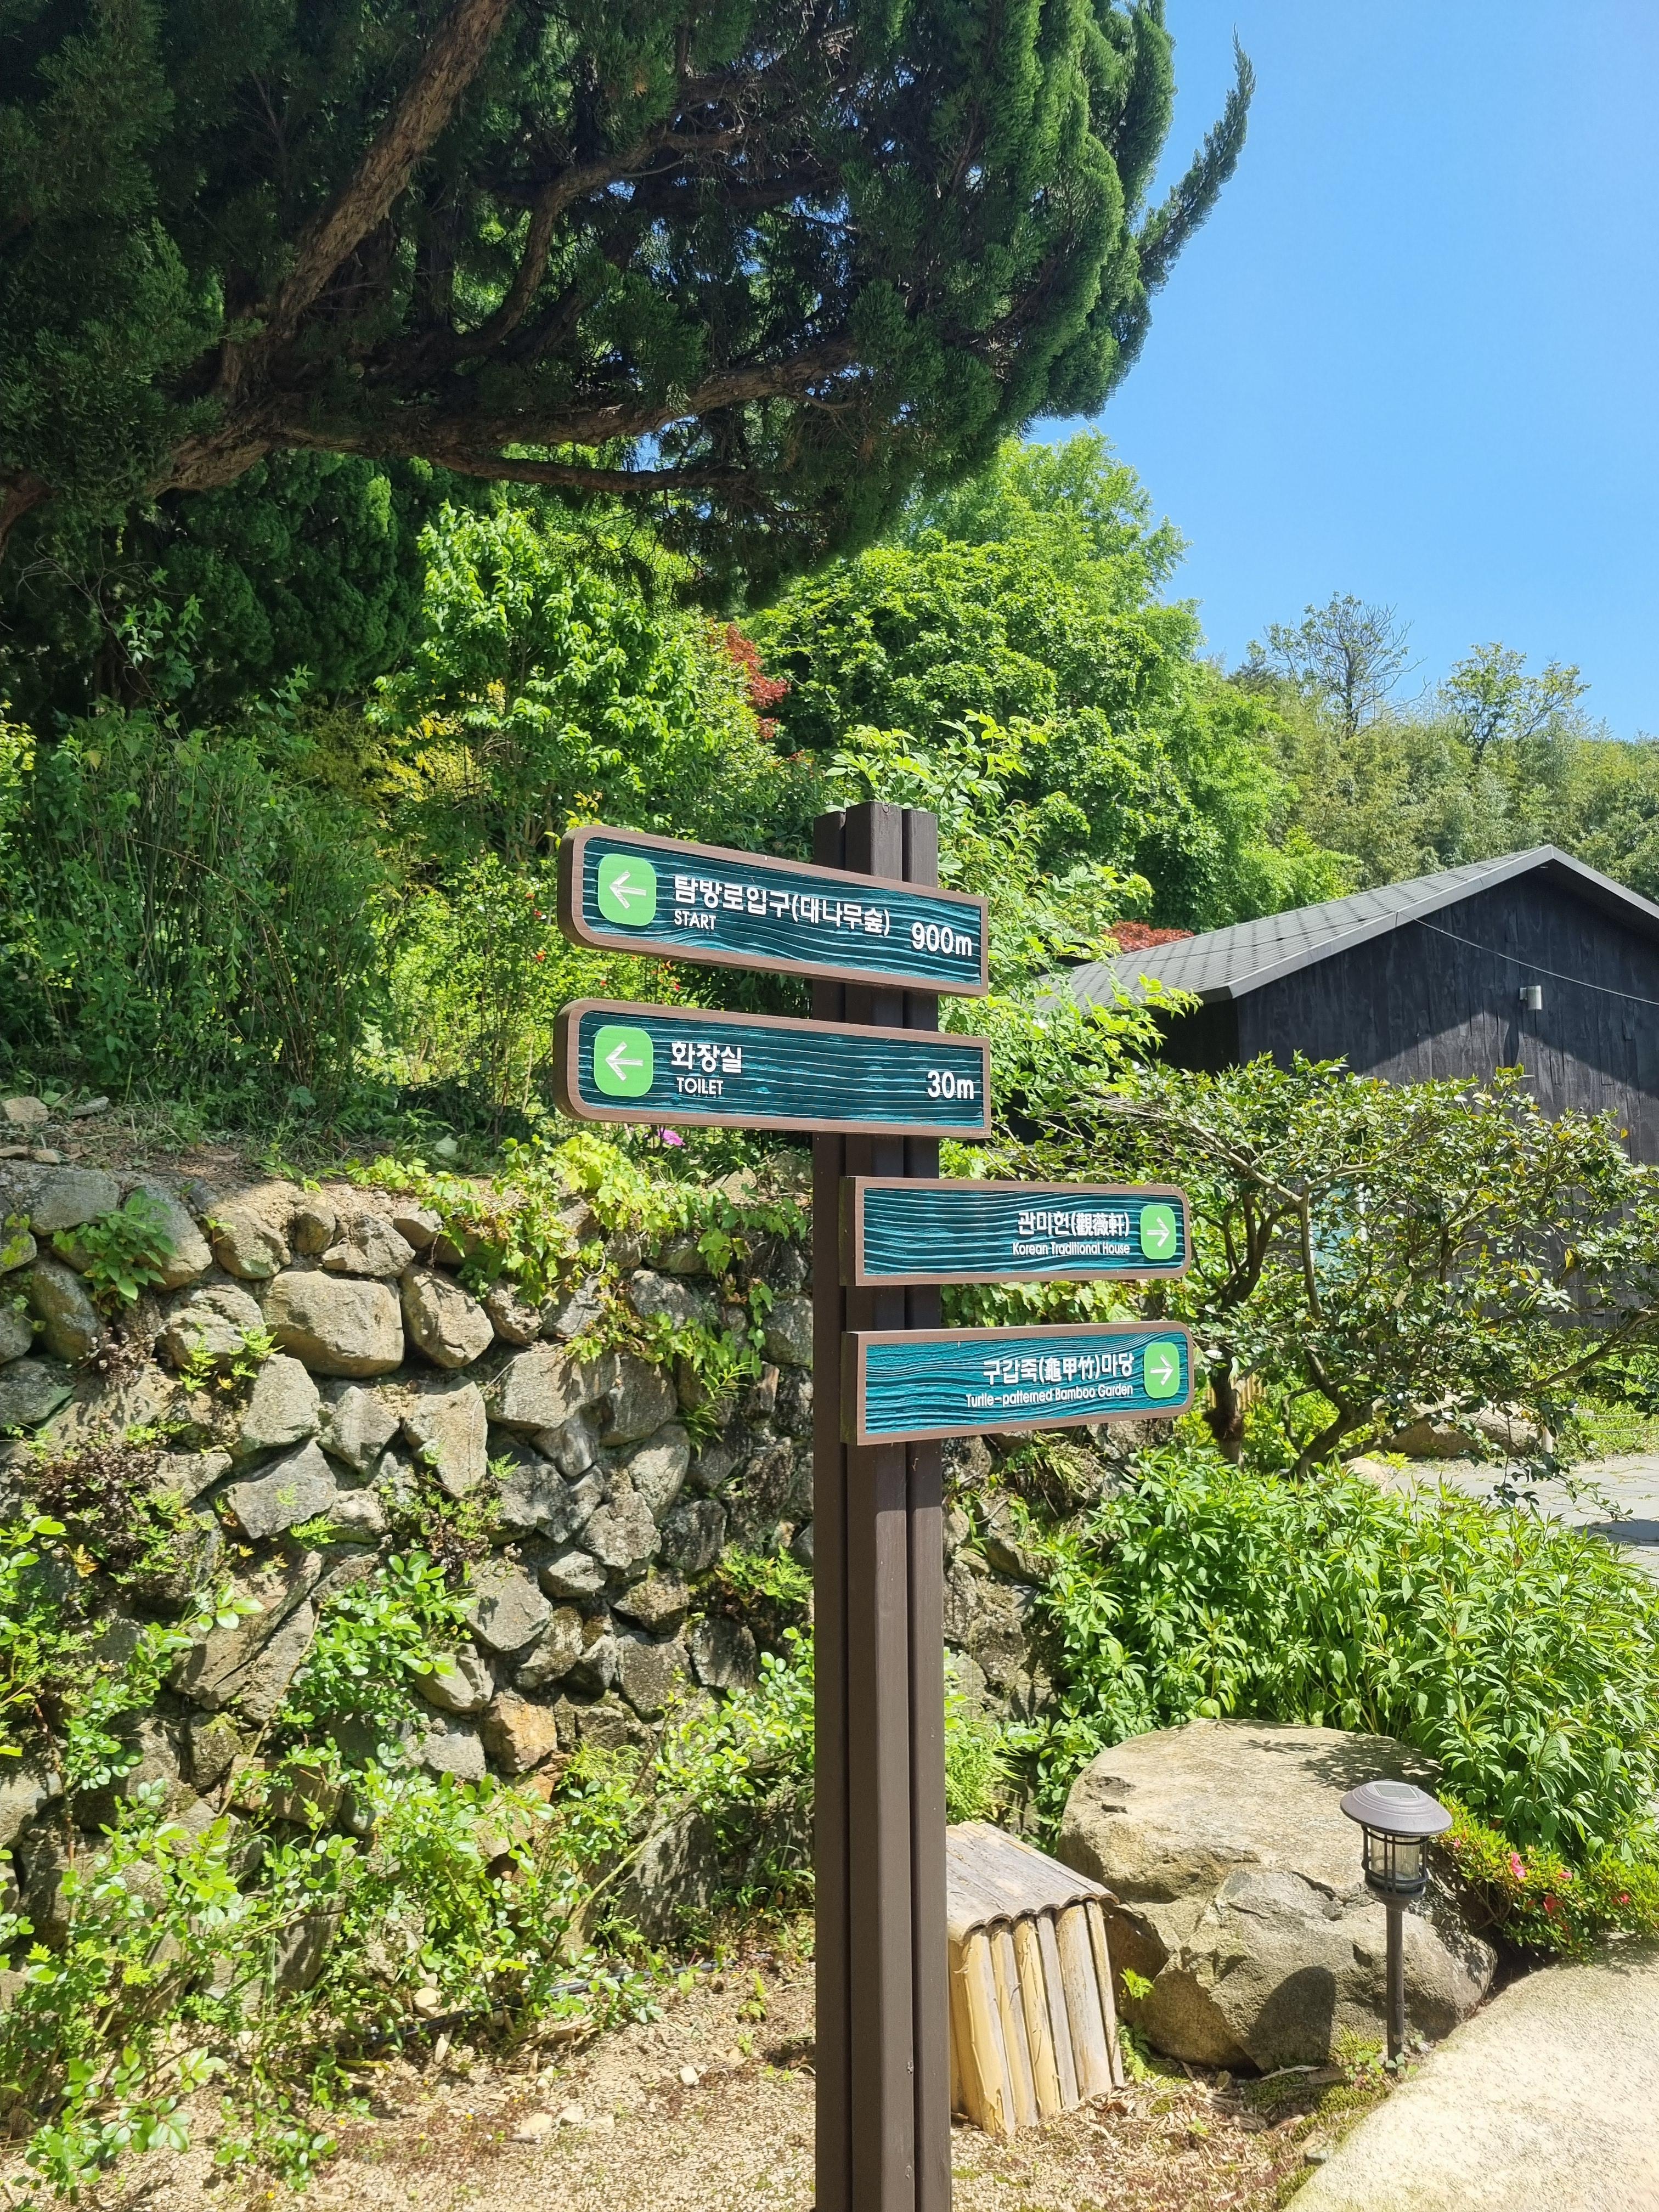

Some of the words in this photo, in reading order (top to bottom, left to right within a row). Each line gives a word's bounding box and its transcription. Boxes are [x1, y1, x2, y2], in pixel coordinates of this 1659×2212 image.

[674, 876, 890, 936] 탐방로입구(대나무숲)
[674, 910, 716, 930] START
[912, 922, 973, 957] 900m
[671, 1041, 742, 1074] 화장실
[677, 1077, 724, 1096] TOILET
[927, 1070, 975, 1100] 30m
[1013, 1242, 1048, 1255] Korean
[1050, 1242, 1100, 1255] Traditional
[1102, 1242, 1130, 1254] House
[983, 1352, 1135, 1385] 구갑죽(龜甲竹)마당
[966, 1387, 1052, 1408] Turtle-patterned
[1054, 1386, 1095, 1401] Bamboo
[1097, 1383, 1133, 1397] Garden
